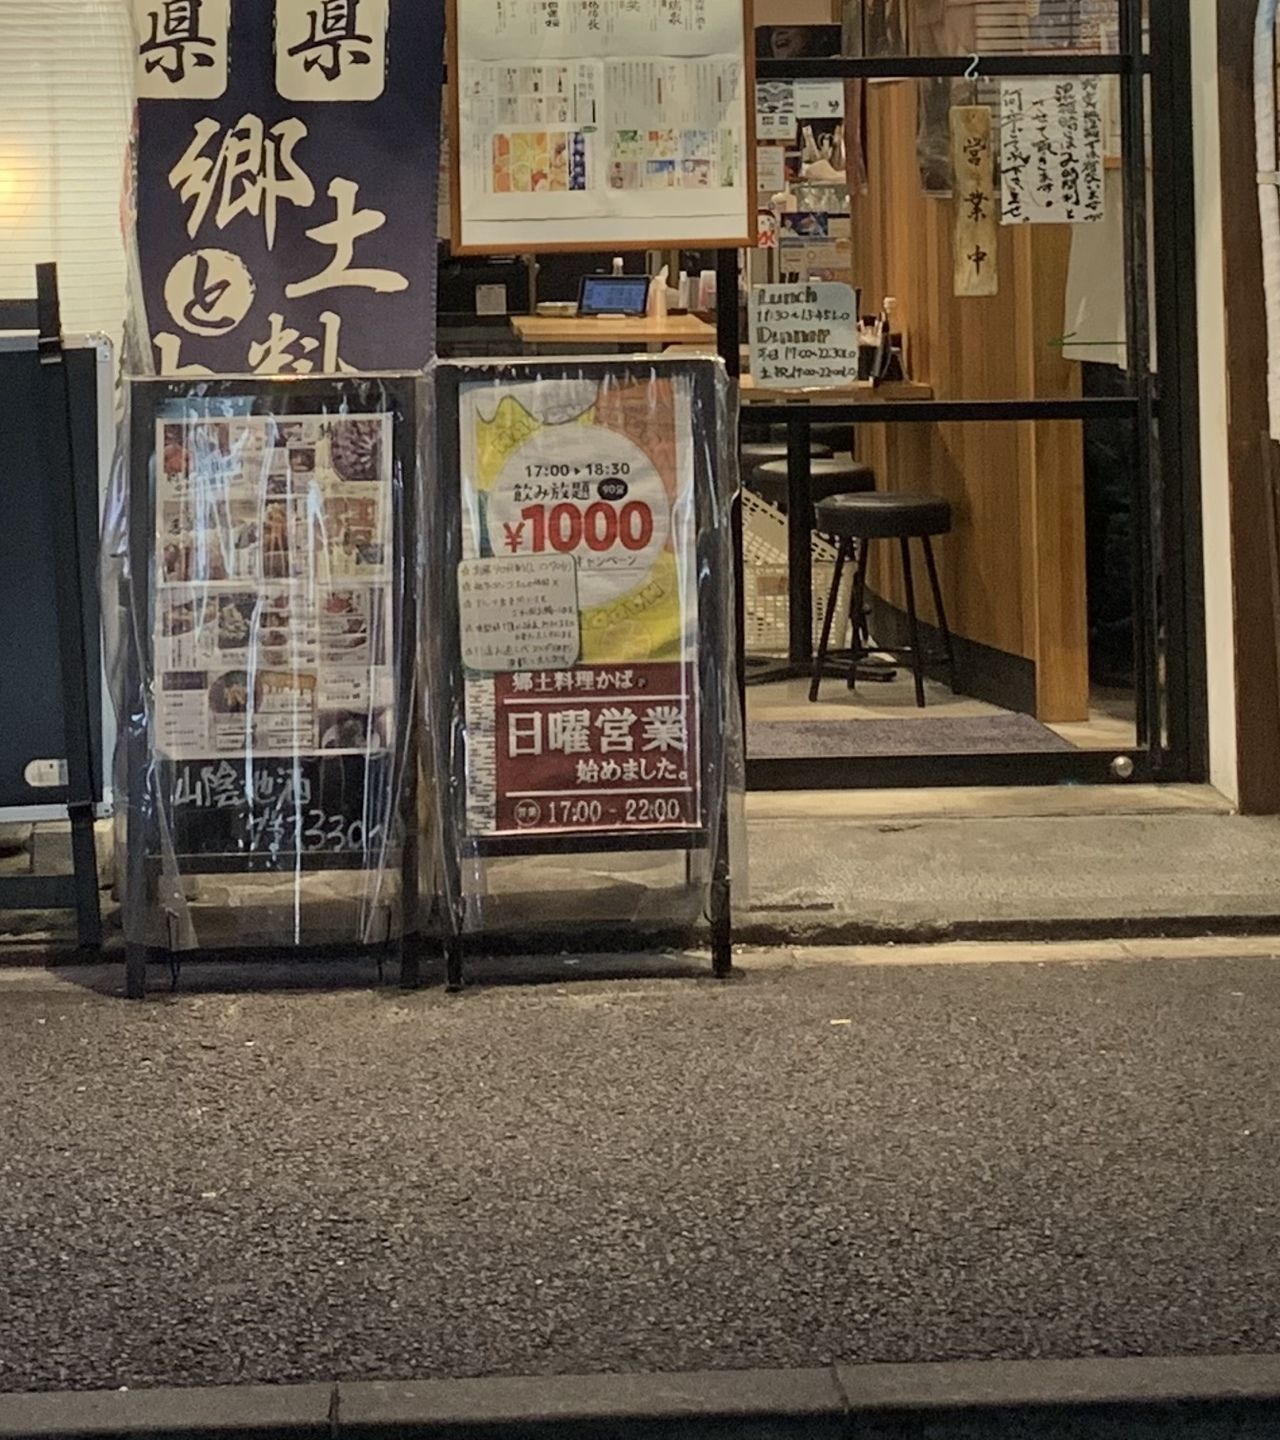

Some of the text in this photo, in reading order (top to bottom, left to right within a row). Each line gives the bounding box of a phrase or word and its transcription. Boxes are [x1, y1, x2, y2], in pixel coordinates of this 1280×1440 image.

[962, 136, 989, 275] 営業中
[758, 286, 818, 306] Lunch
[525, 462, 630, 477] 17:00 18:30
[513, 481, 590, 502] 飲み放題
[503, 500, 654, 553] ¥1000
[507, 706, 688, 758] 日曜営業
[576, 757, 688, 784] 始めました。
[549, 800, 602, 823] 17:00
[625, 798, 680, 822] 22:00
